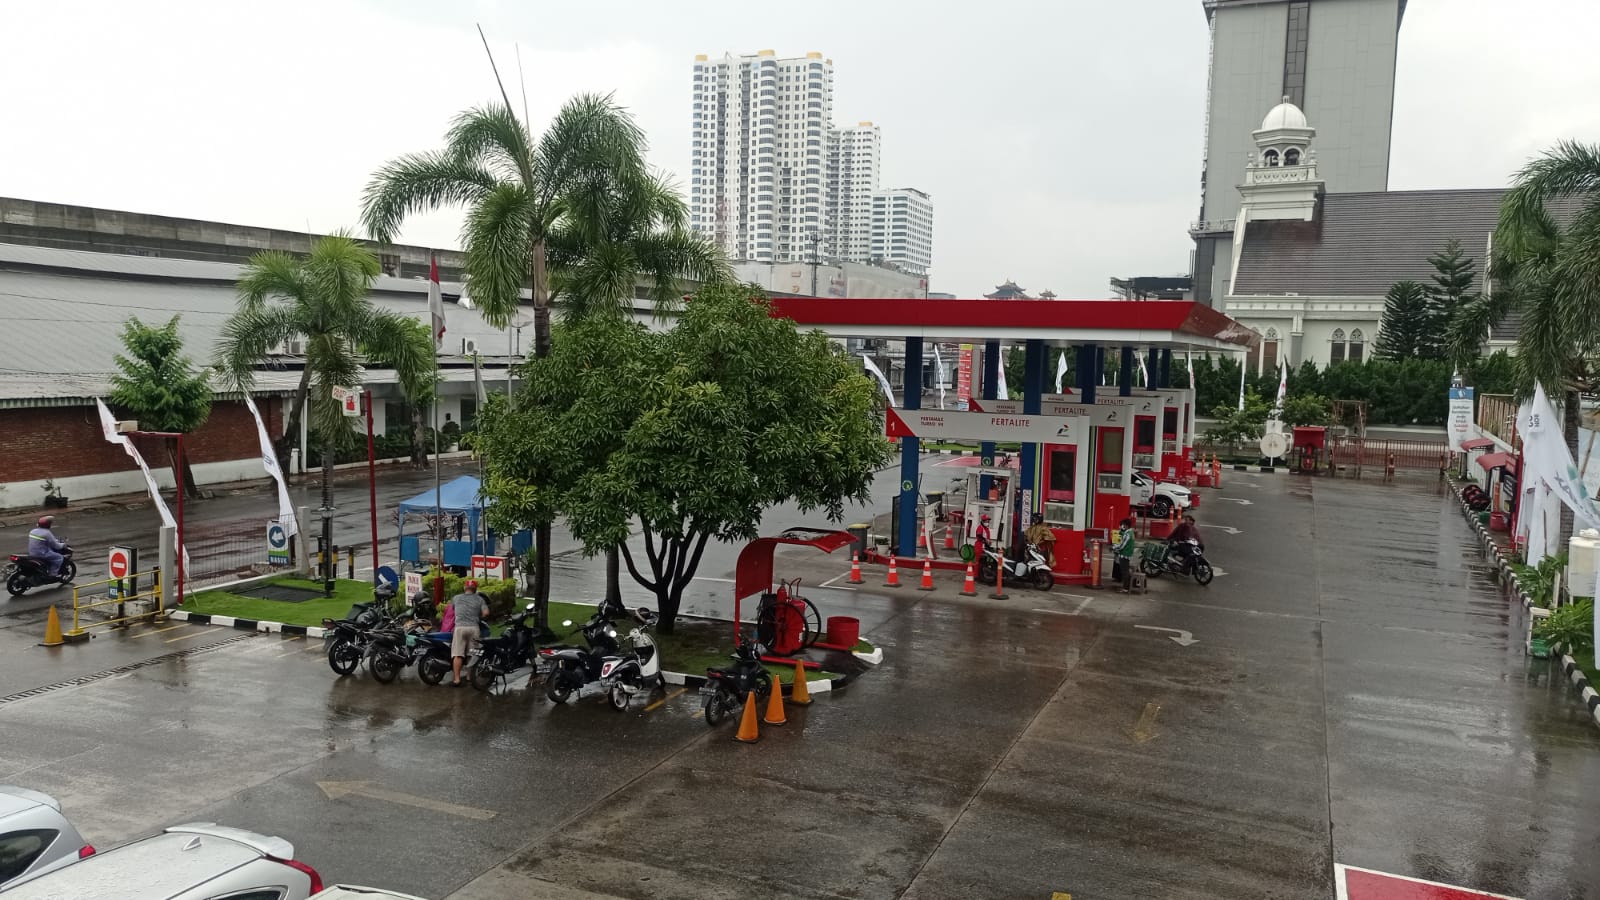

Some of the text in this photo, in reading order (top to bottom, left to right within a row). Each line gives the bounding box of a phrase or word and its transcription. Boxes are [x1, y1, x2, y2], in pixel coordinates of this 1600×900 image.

[1054, 406, 1087, 416] PERTALITE
[890, 422, 896, 431] 1
[991, 417, 1030, 427] PERTALITE
